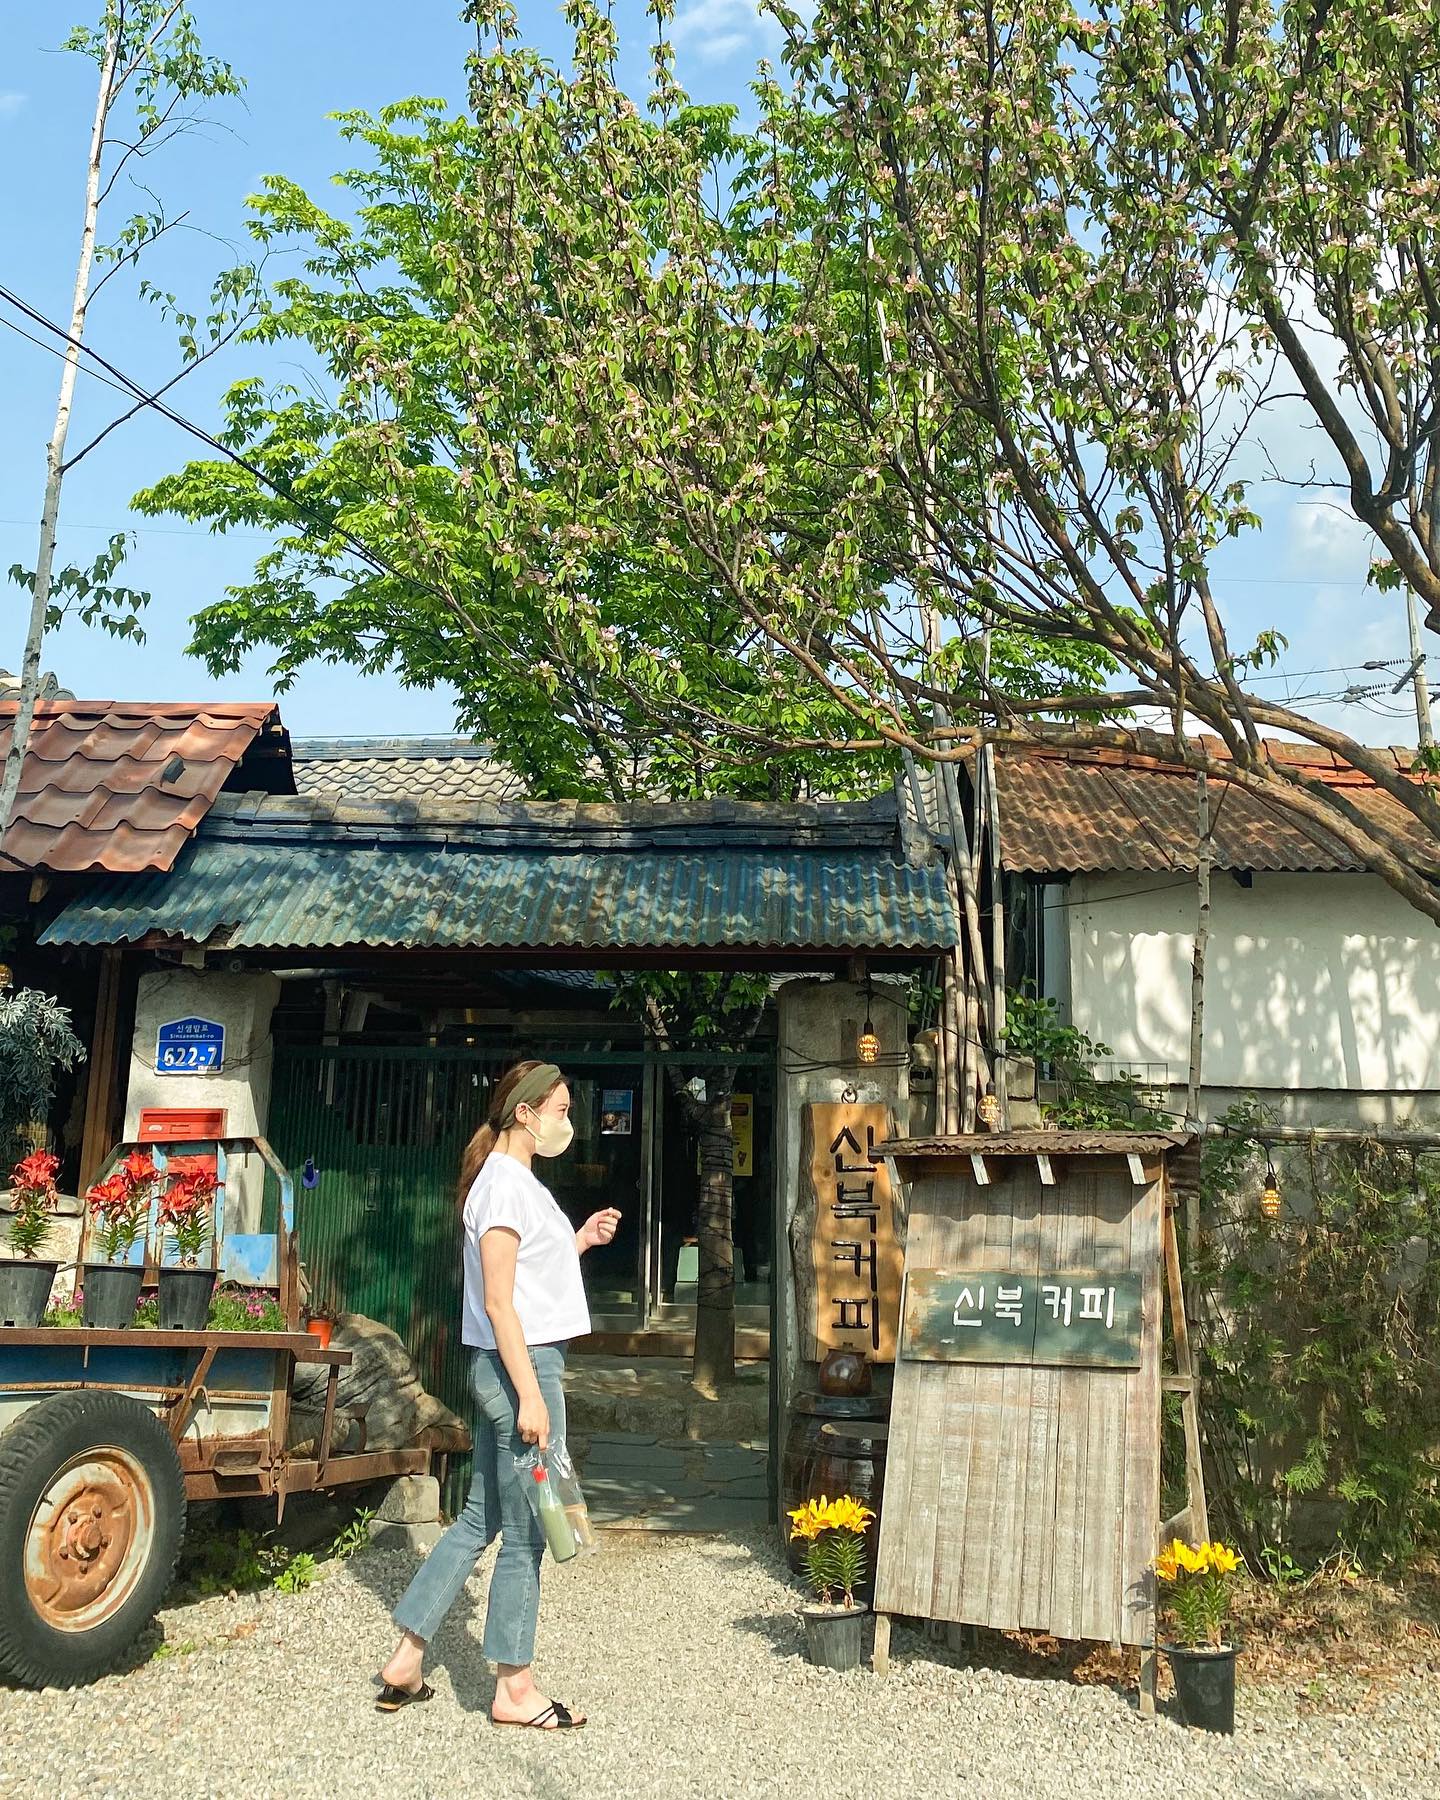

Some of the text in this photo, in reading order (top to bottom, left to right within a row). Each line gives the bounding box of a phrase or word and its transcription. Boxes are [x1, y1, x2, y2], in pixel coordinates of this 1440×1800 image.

[164, 1046, 218, 1066] 622-7
[952, 1285, 1116, 1329] 신북 커피
